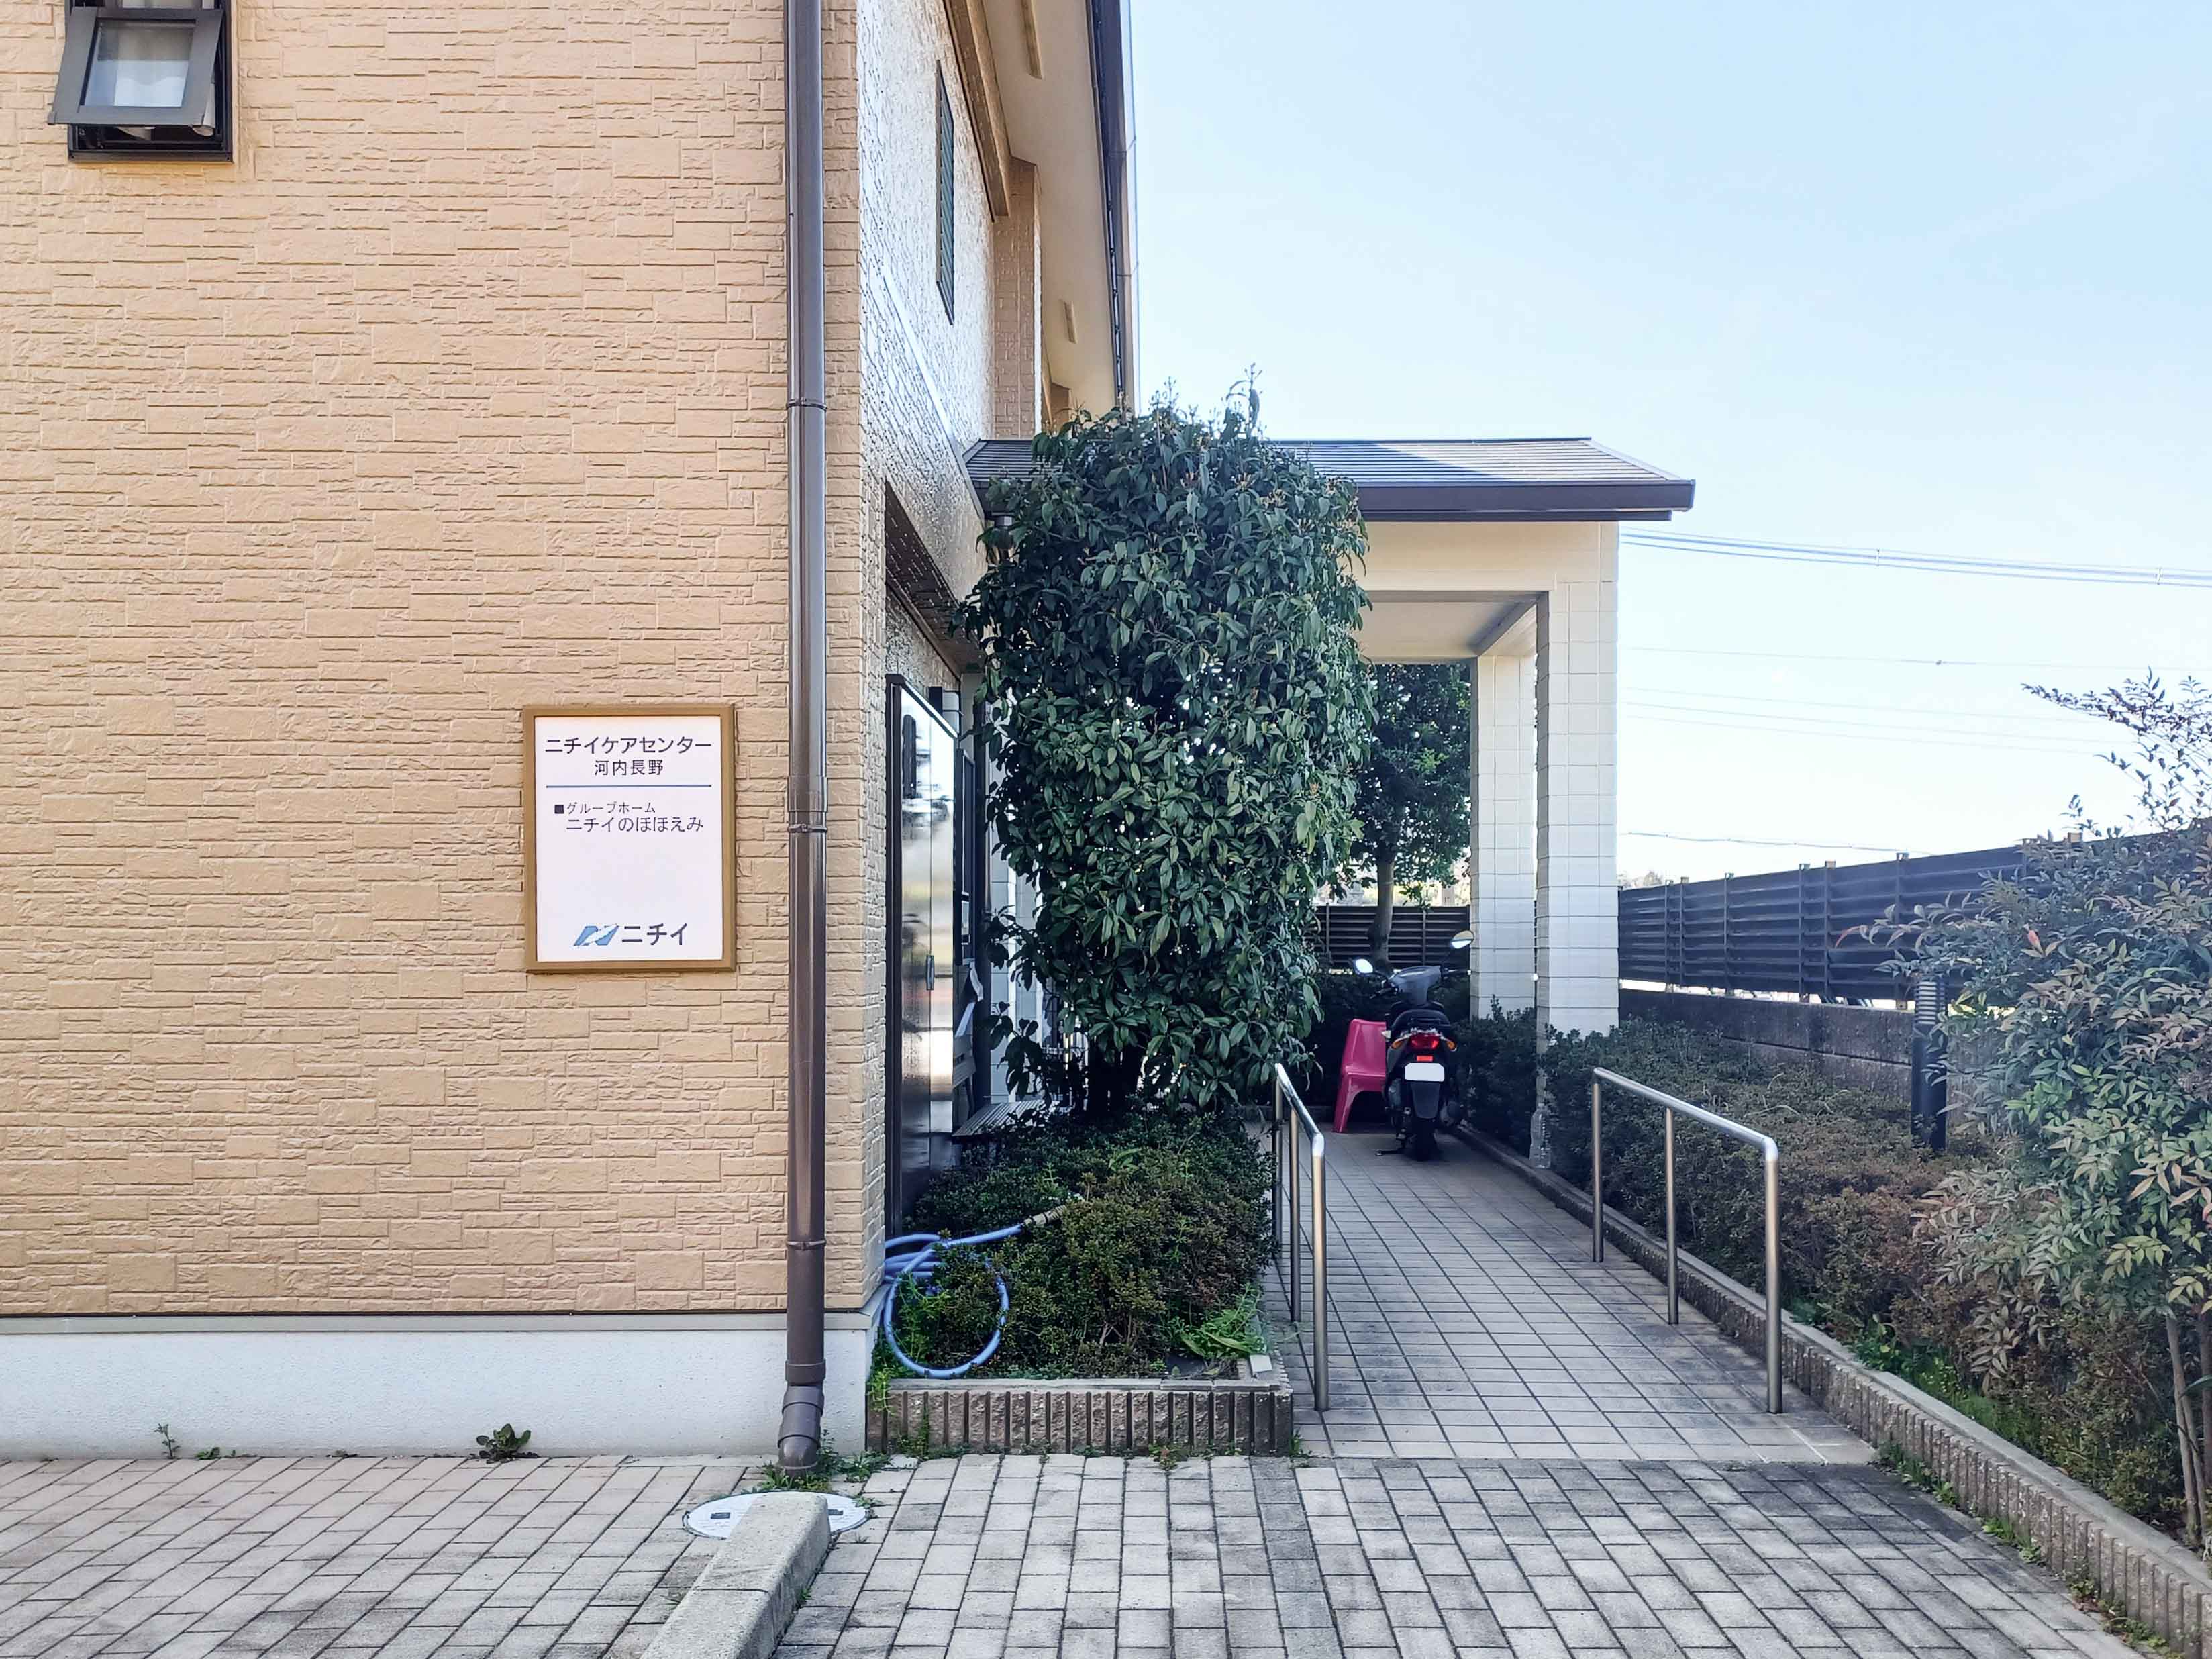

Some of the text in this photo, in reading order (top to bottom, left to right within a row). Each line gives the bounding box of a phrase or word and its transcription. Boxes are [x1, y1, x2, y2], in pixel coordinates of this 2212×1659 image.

[545, 736, 711, 754] ニチイケアセンター
[594, 760, 664, 776] 河内長野
[566, 817, 704, 833] ニチイのほほえみ
[621, 923, 688, 946] ニチイ
